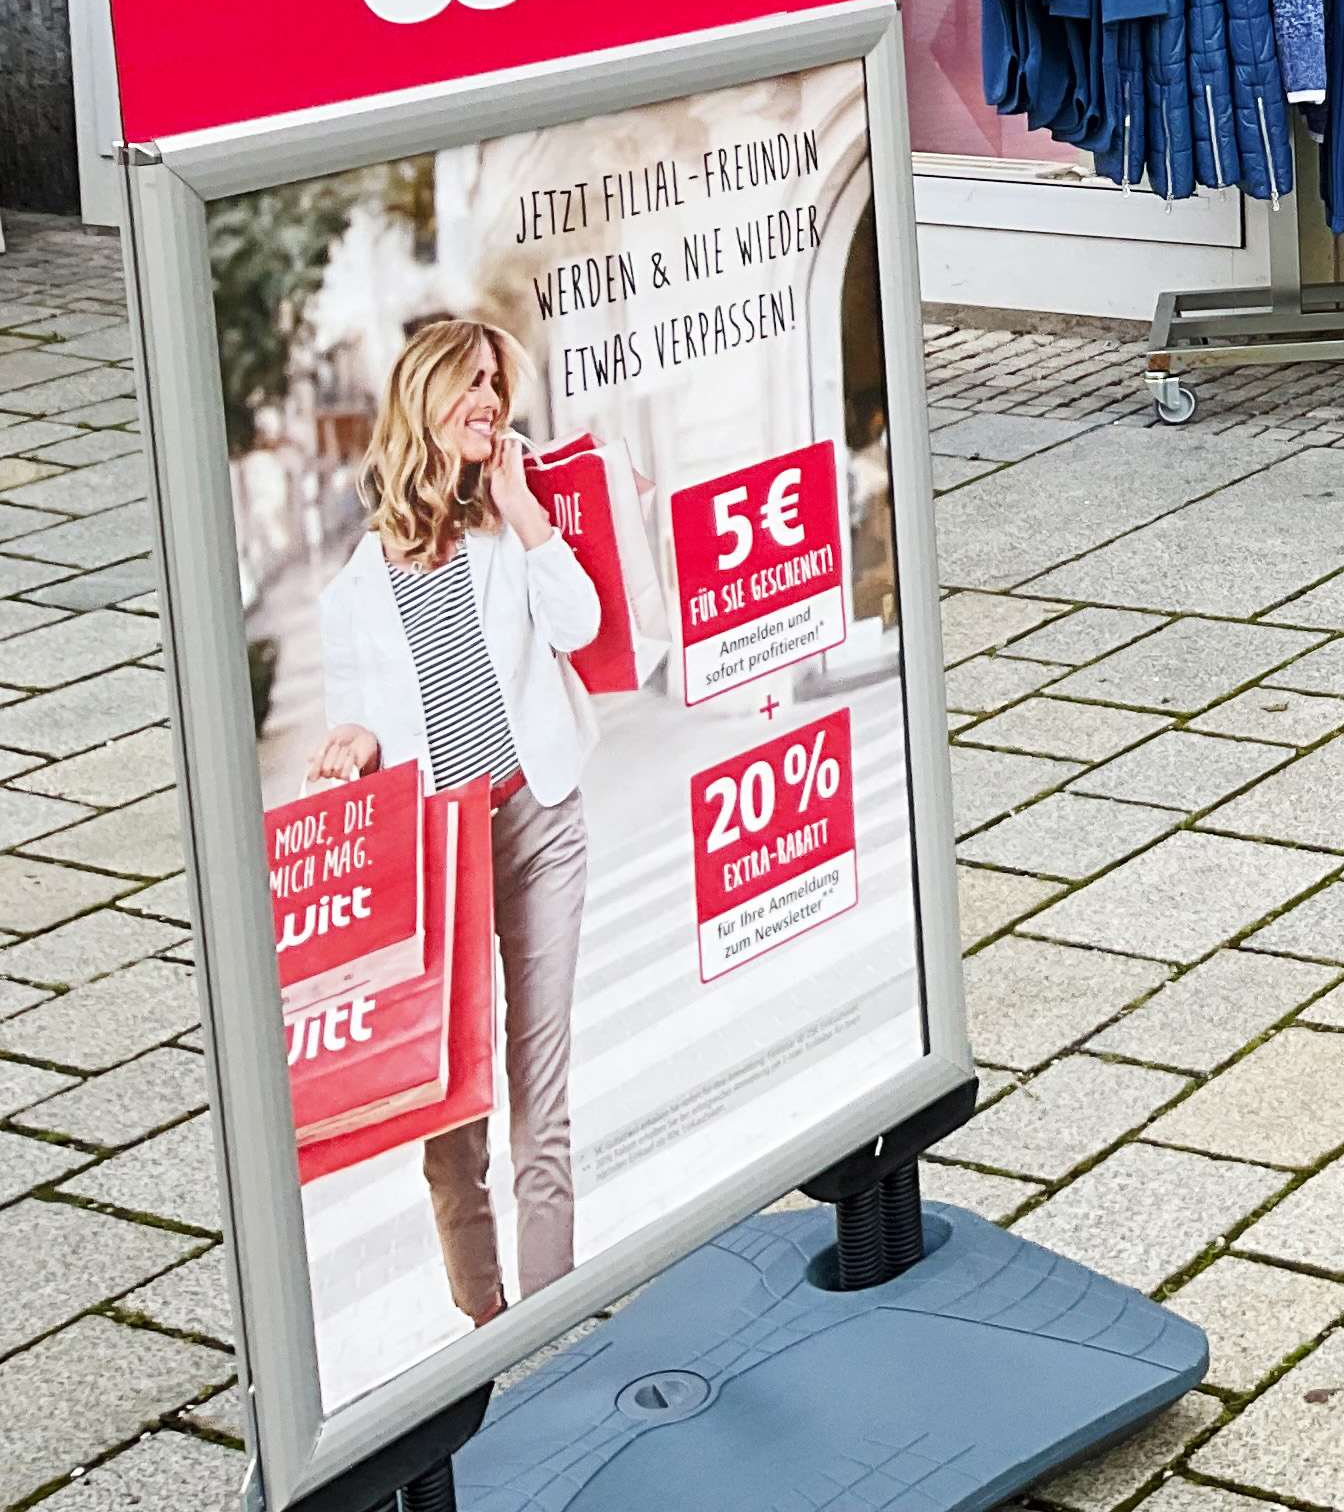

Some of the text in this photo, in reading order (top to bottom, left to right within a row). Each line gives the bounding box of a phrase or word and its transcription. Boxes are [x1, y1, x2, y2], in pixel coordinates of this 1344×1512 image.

[517, 182, 589, 244] JETZT
[533, 204, 821, 321] WERDEN & NIE WIEDER
[564, 285, 797, 398] ETWAS VERPASSEN!
[553, 491, 583, 536] DIE
[689, 544, 834, 626] FÜR SIE GESCHENKT!
[719, 605, 811, 658] Anmelden und
[705, 656, 745, 686] sofort
[274, 794, 376, 860] MODE, DIE
[723, 818, 829, 892] EXTRA-RABATT
[269, 836, 373, 899] MICH MAG.
[717, 868, 840, 941] für Ihre Anmeldung
[724, 936, 751, 960] zum
